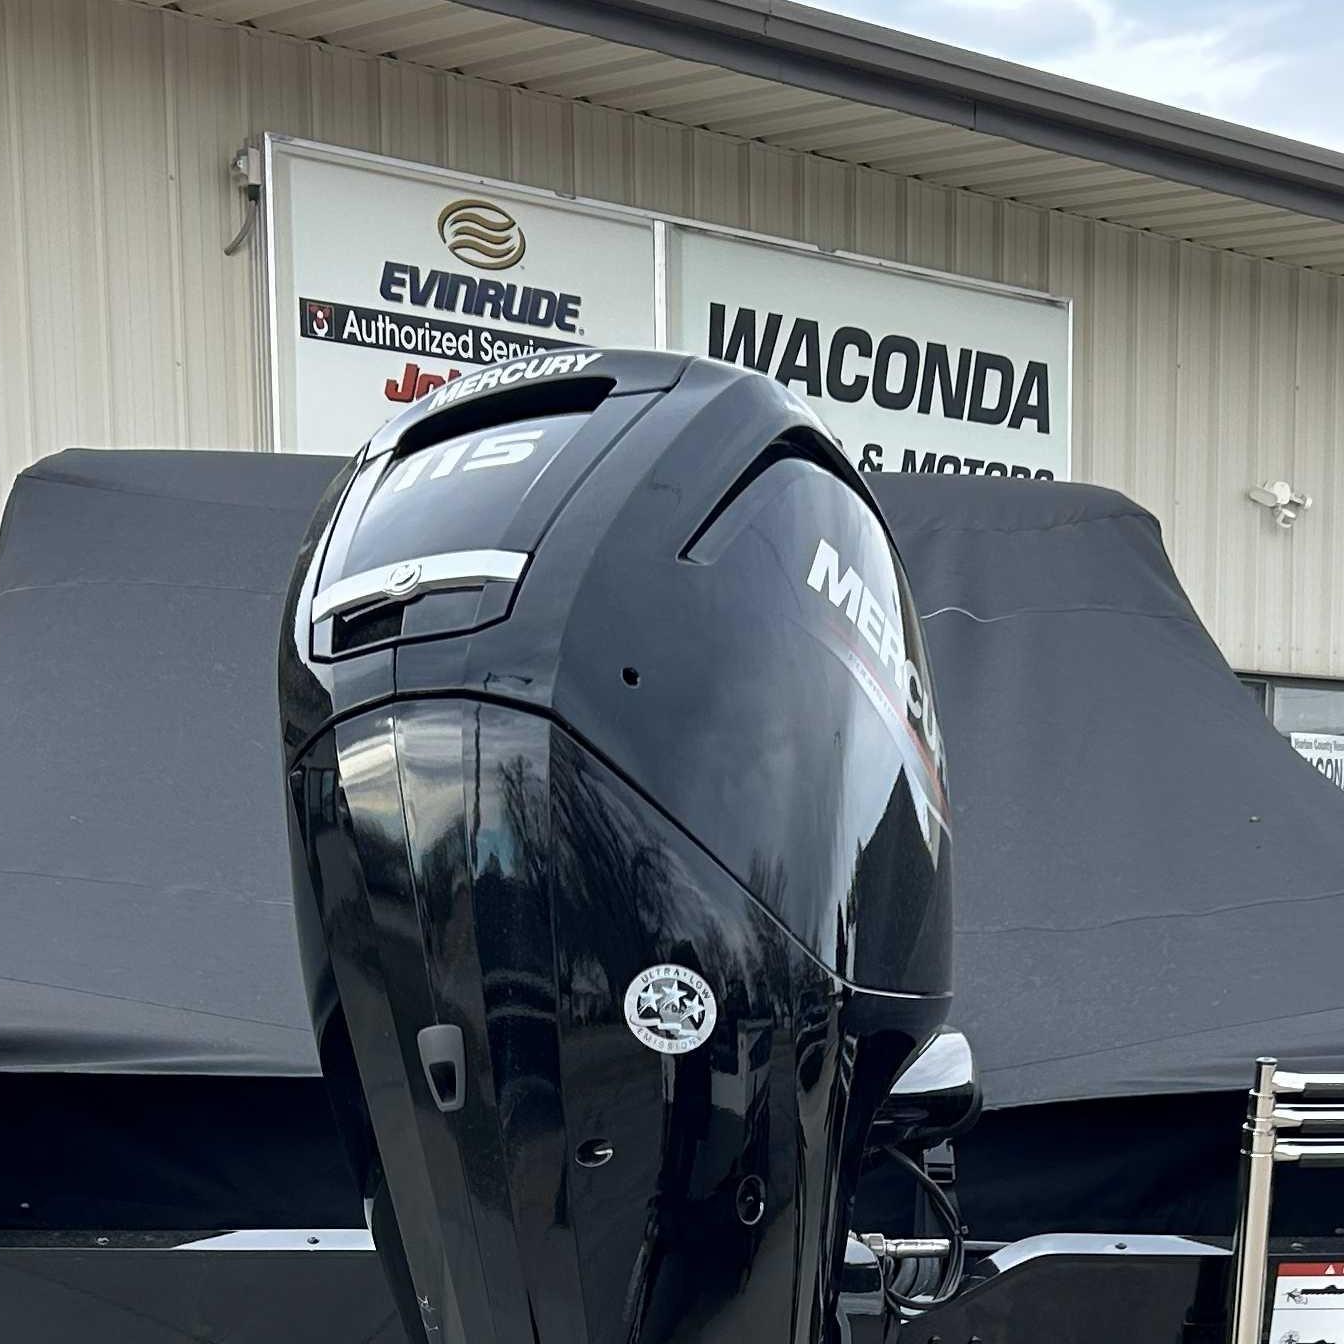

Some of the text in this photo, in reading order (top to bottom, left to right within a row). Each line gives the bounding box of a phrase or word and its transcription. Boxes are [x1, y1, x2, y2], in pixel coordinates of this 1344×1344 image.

[379, 260, 582, 334] EVINRUDE
[342, 309, 474, 360] Authorized
[424, 351, 606, 412] MERCURY
[708, 302, 1052, 435] WACONDA
[392, 429, 546, 493] 115
